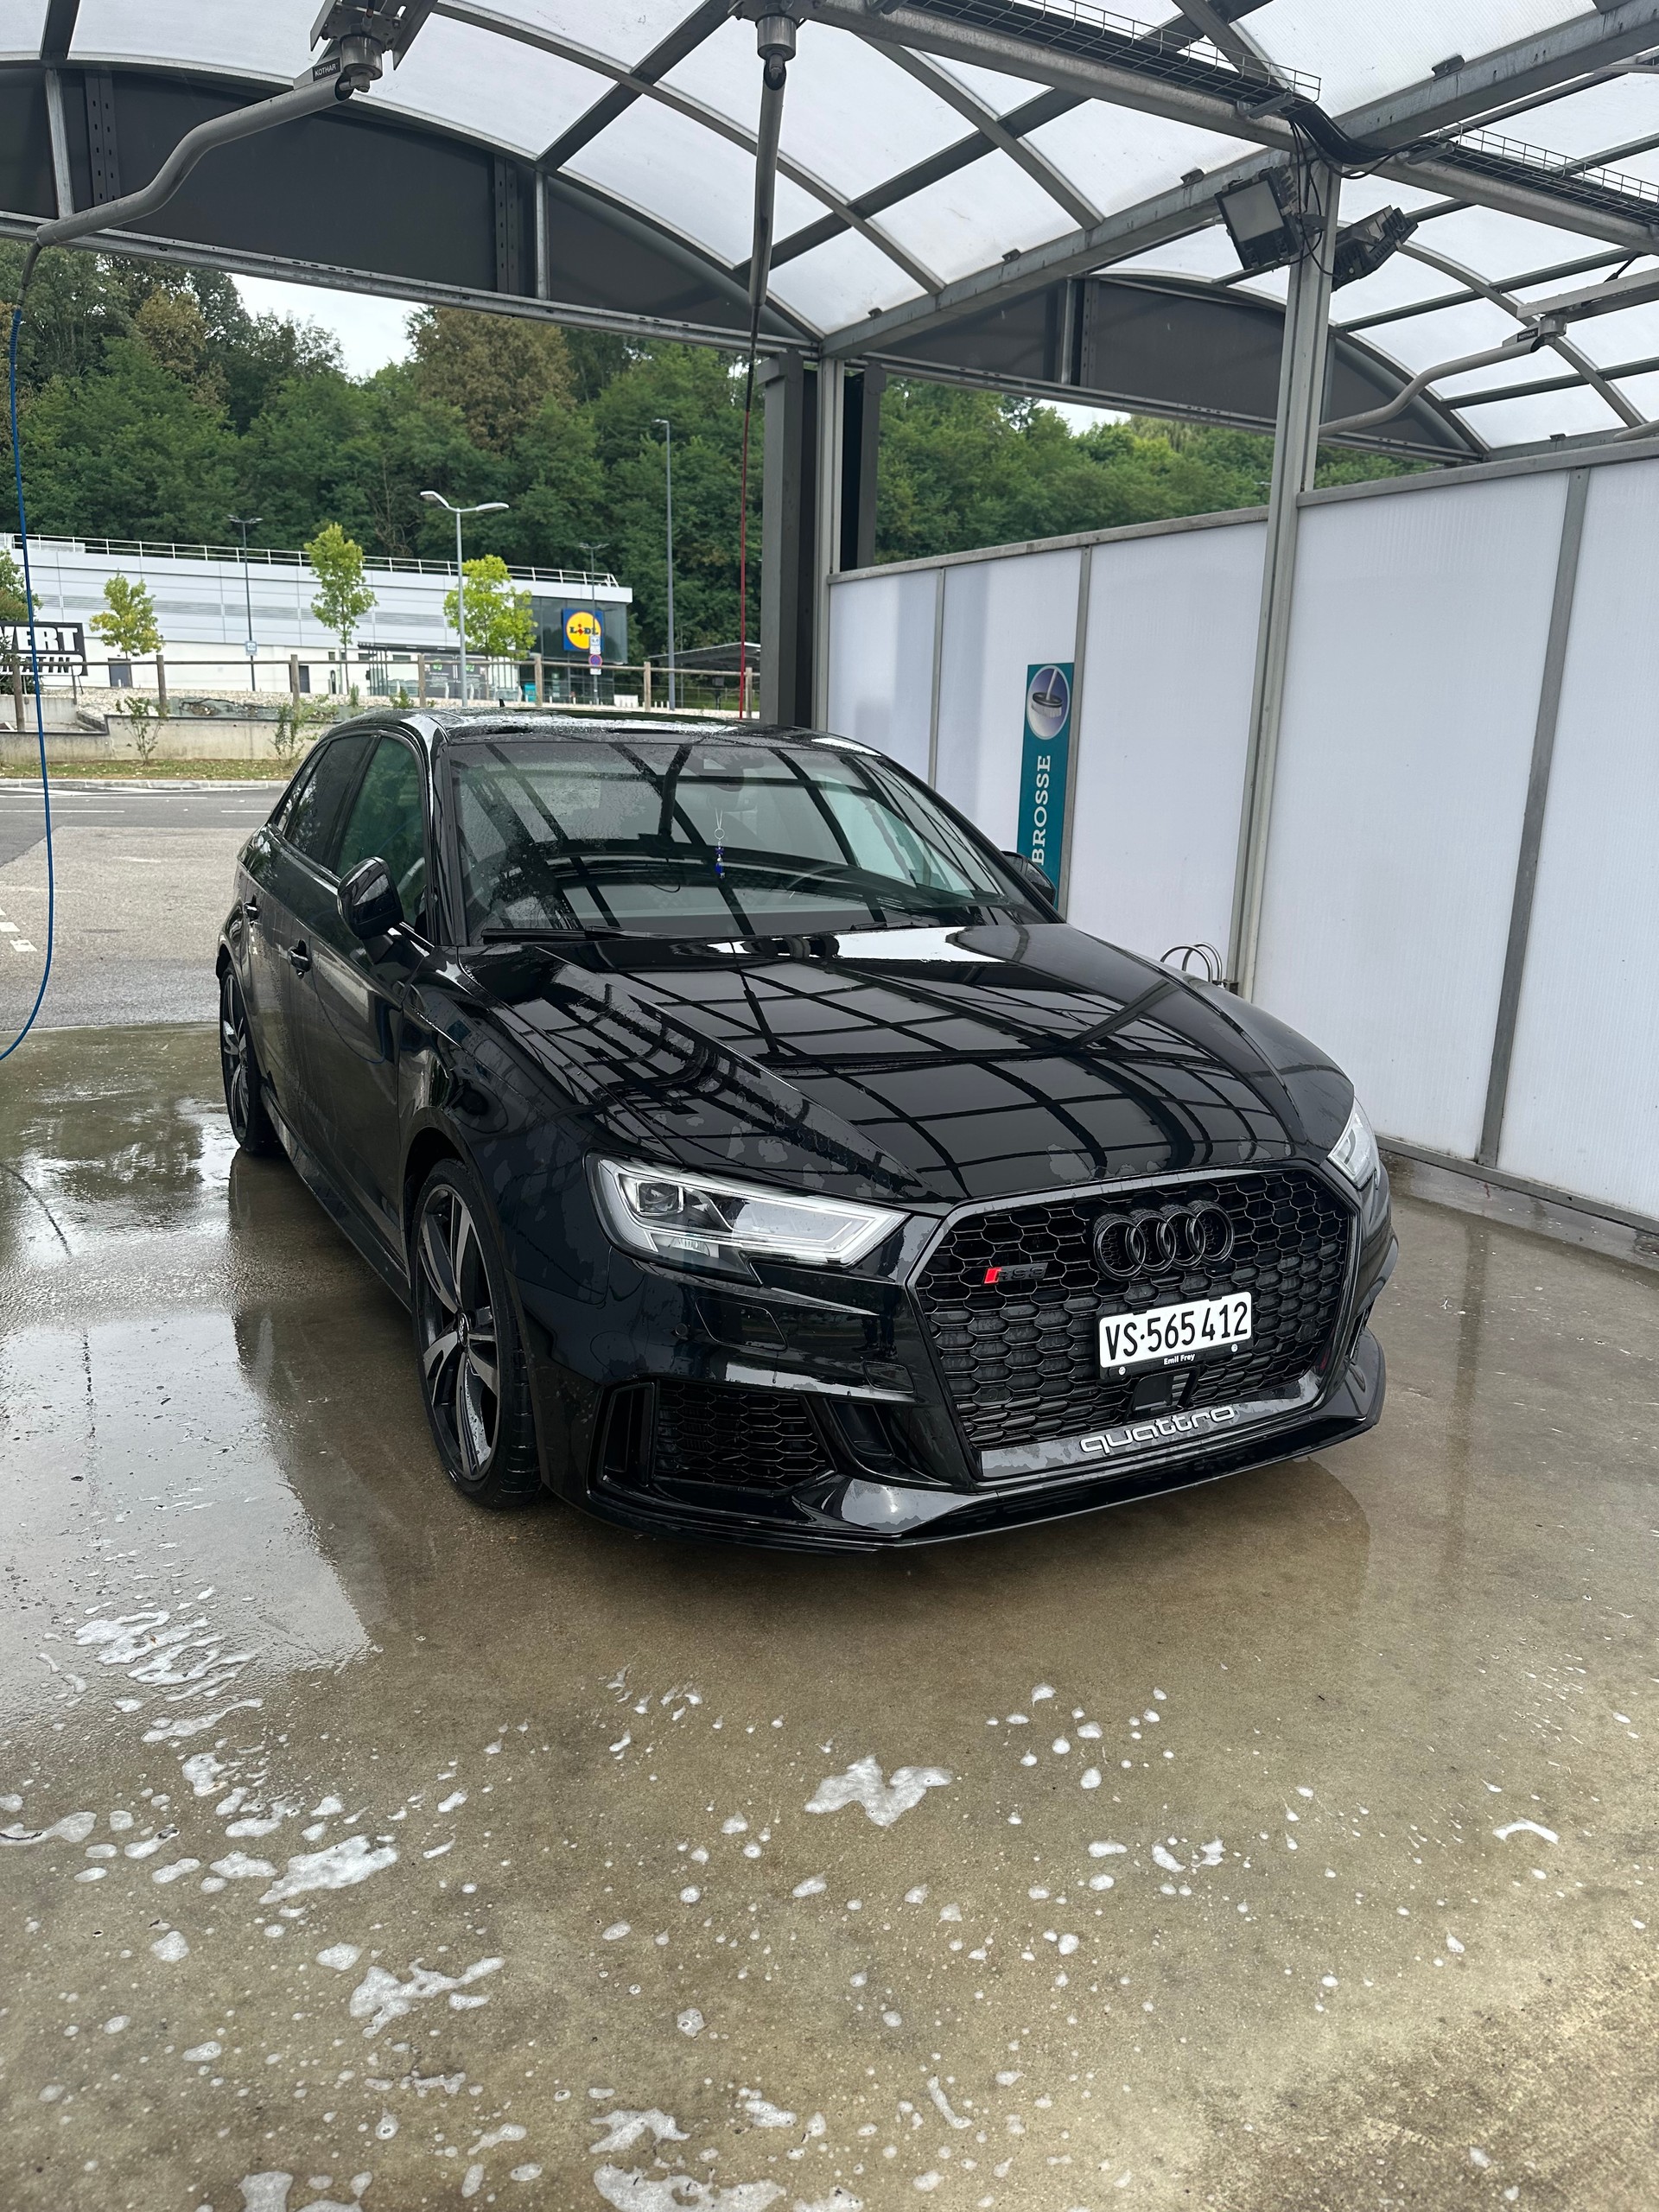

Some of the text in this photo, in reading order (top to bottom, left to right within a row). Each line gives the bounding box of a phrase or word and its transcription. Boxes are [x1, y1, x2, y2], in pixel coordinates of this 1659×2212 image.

[315, 63, 336, 77] KOTHAR
[1032, 755, 1051, 866] BROSSE
[1164, 1356, 1179, 1364] Emil
[1080, 1406, 1235, 1454] quattro
